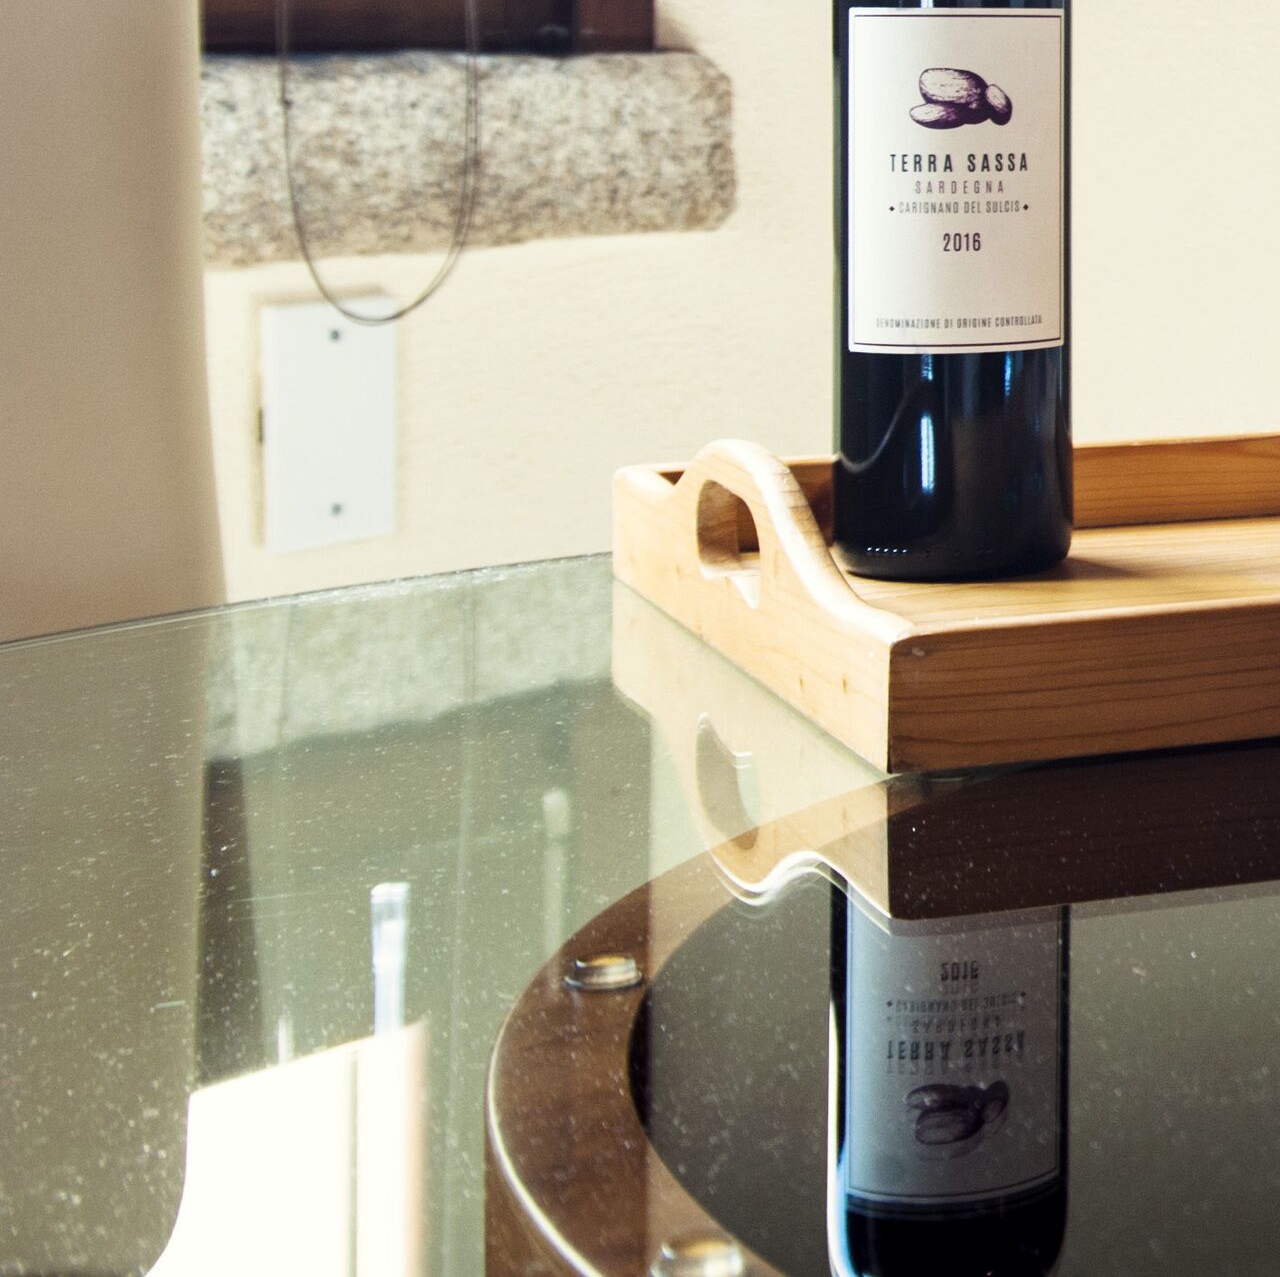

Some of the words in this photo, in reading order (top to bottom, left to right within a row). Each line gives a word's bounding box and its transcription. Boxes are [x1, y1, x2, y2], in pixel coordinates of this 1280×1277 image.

[889, 153, 953, 173] TERRA
[967, 152, 1028, 172] SASSA
[915, 180, 1004, 194] SARDEGNA
[899, 201, 959, 214] CARIGNANO
[964, 201, 981, 213] DEL
[985, 200, 1020, 213] SULCIS
[943, 232, 981, 252] 2016
[944, 317, 953, 329] DI
[956, 317, 992, 329] ORIGINE
[994, 314, 1042, 328] CONTROLLATA
